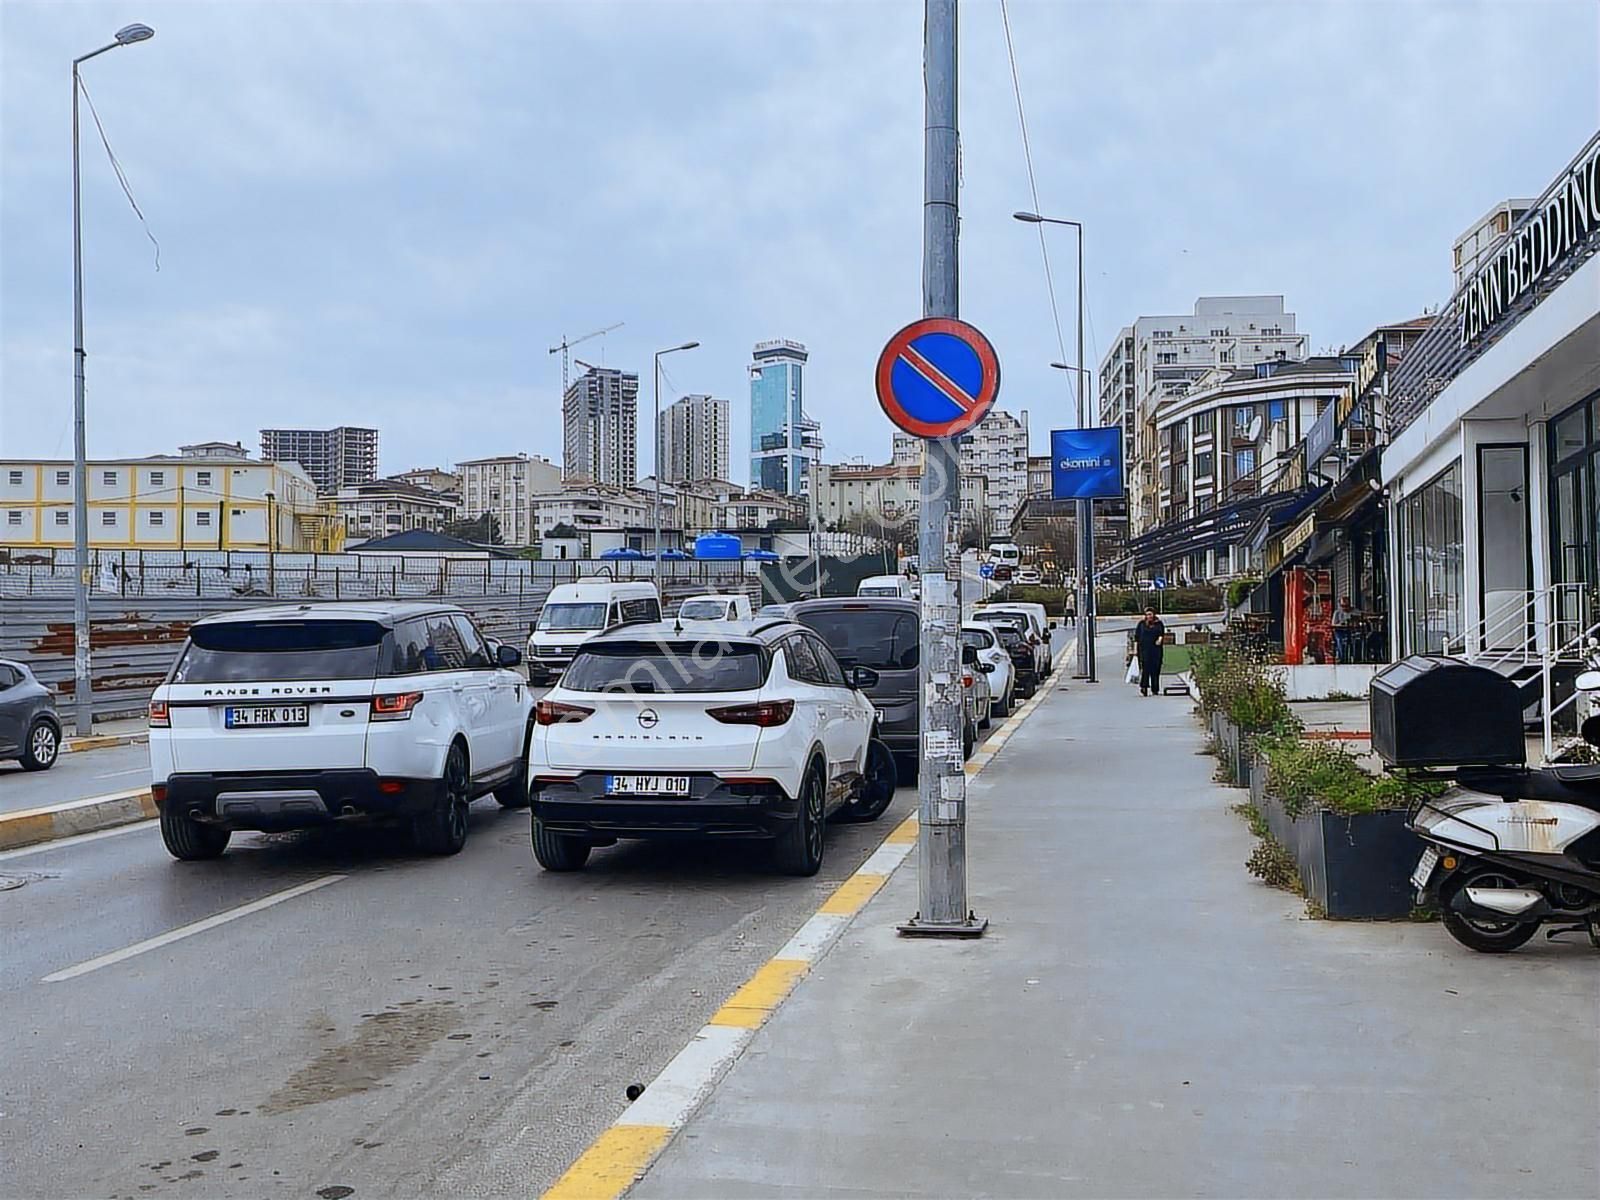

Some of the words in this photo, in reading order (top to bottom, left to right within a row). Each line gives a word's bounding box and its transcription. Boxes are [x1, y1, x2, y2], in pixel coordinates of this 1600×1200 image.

[1460, 255, 1503, 350] ZENN
[204, 688, 259, 696] RANGE
[271, 686, 330, 694] ROVER
[234, 709, 248, 723] 34
[254, 708, 276, 722] FRK
[282, 707, 305, 721] 013
[614, 777, 628, 791] 34
[635, 777, 659, 791] HYJ
[665, 778, 687, 792] 010
